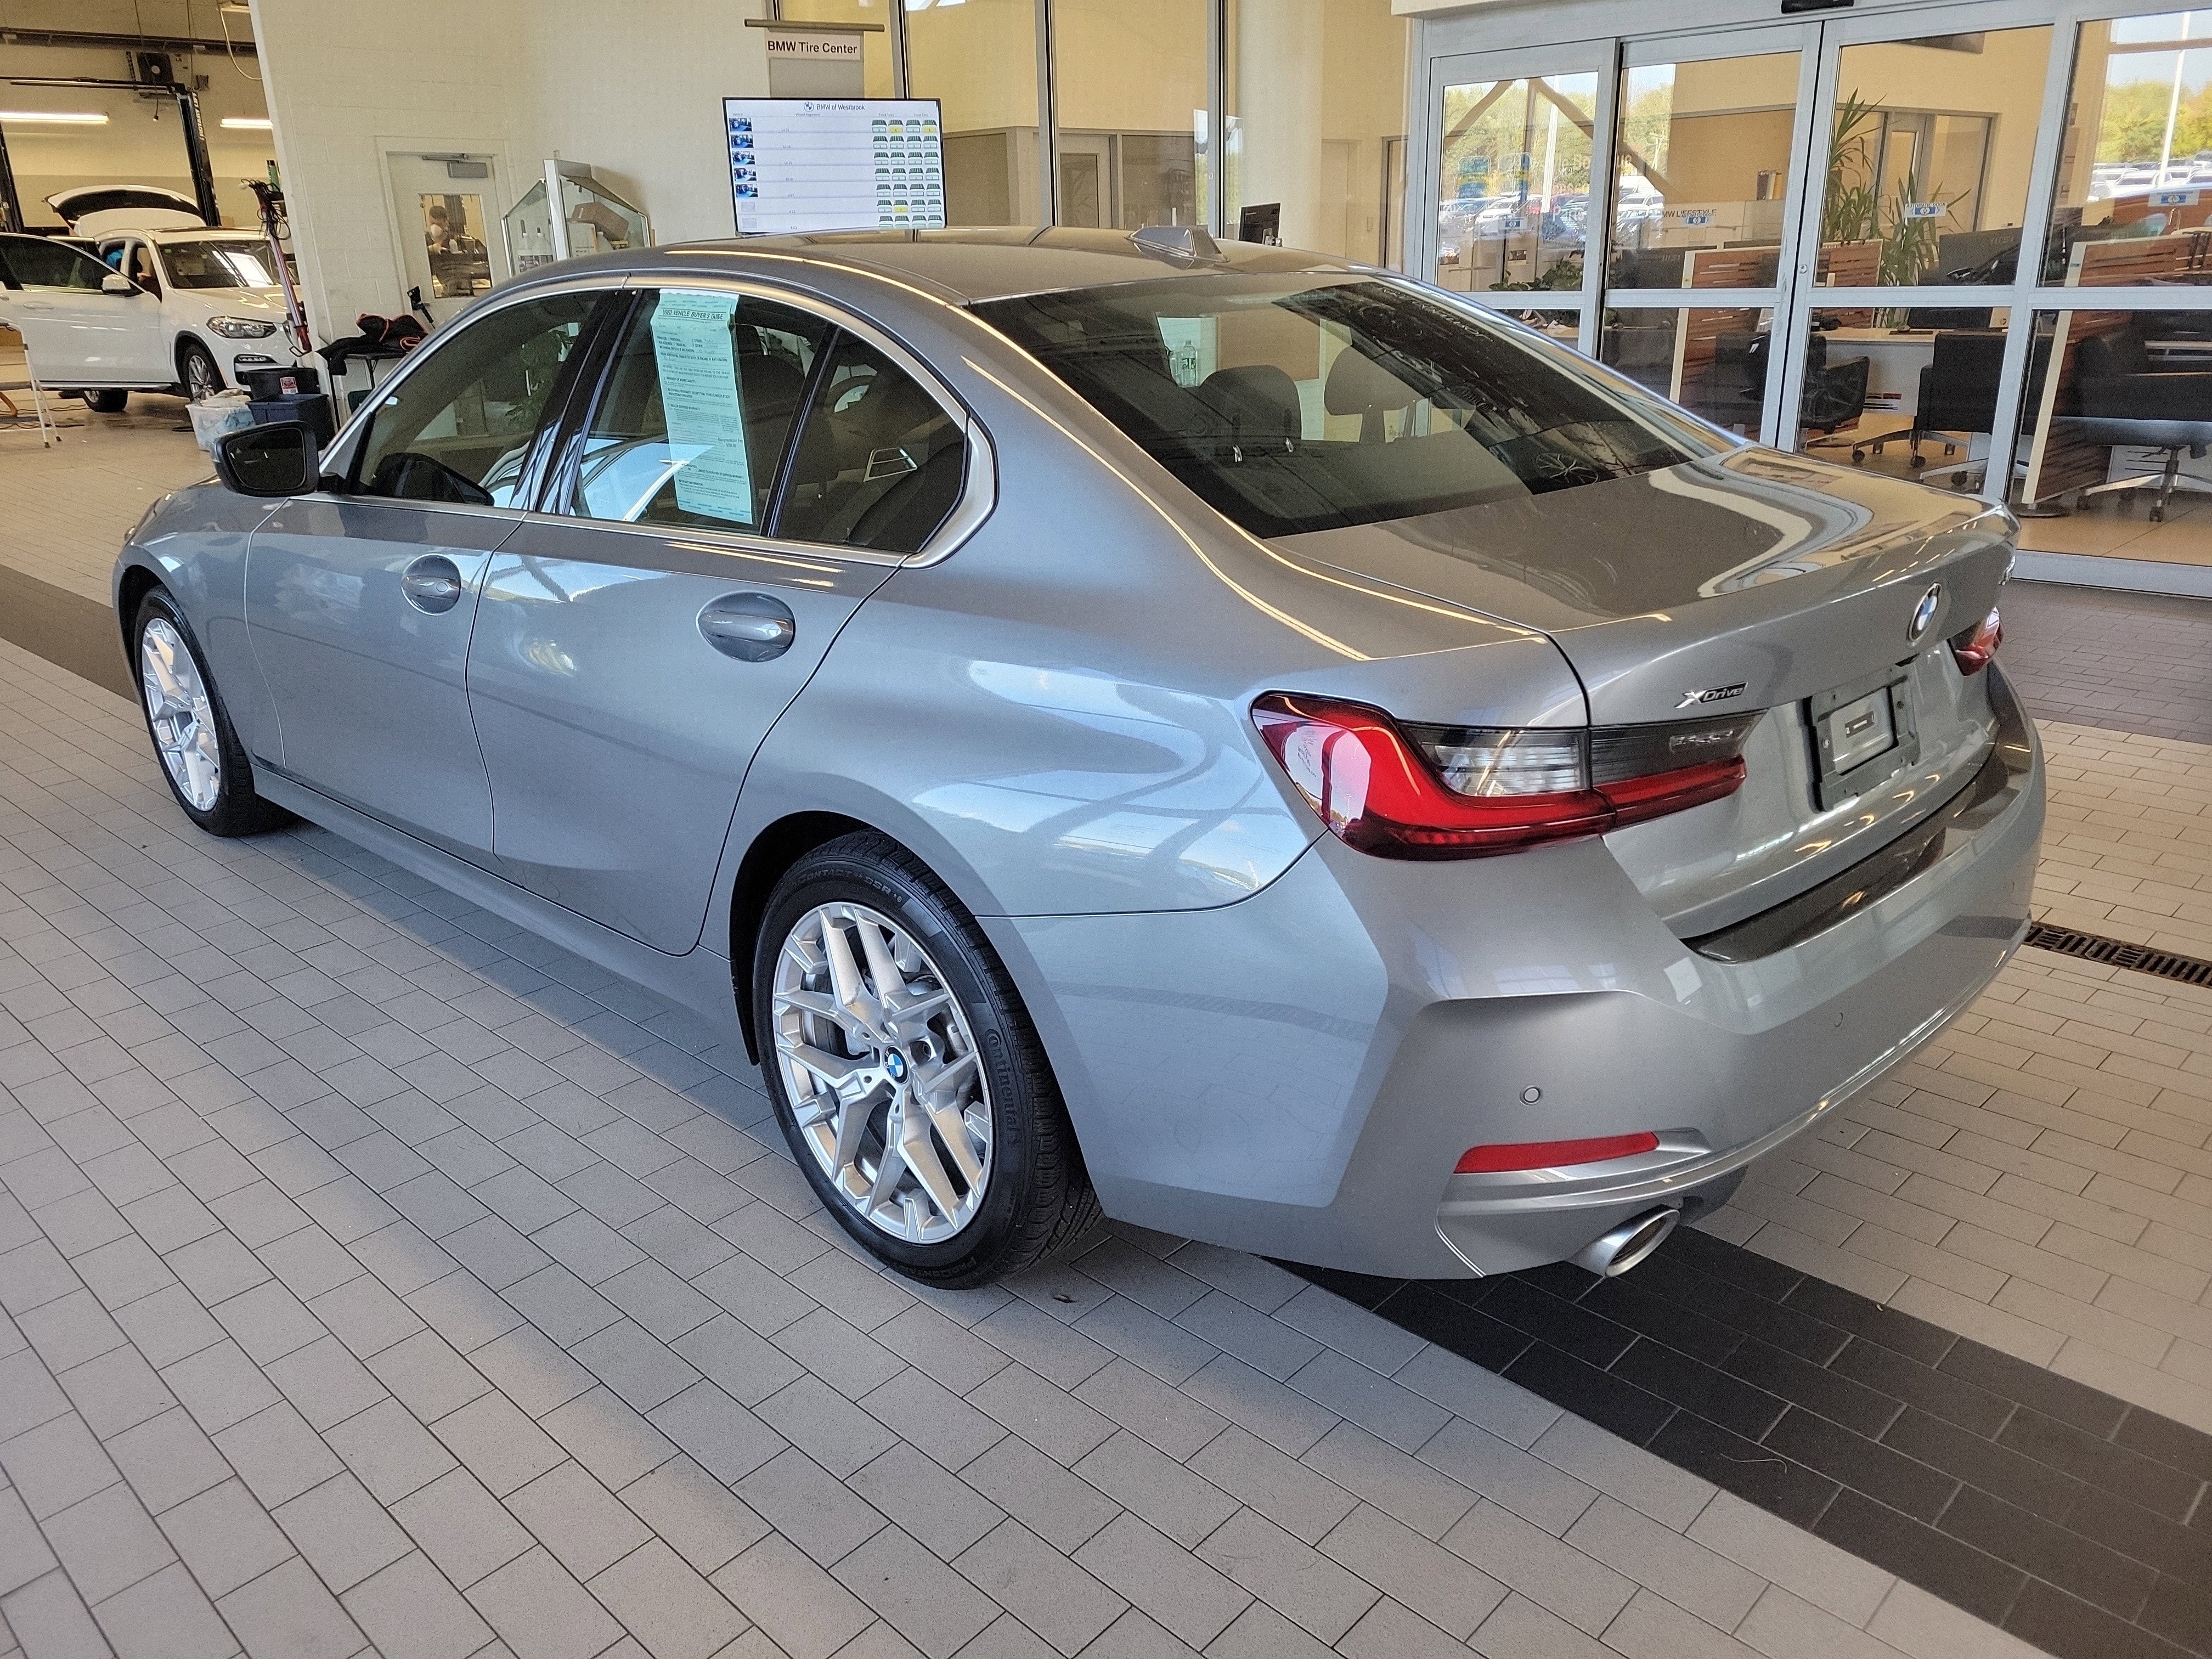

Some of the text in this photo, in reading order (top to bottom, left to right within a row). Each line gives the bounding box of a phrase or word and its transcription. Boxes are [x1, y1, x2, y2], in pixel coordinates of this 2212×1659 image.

[768, 41, 857, 54] BMW Tire Center
[864, 878, 892, 895] SSR
[984, 1029, 1019, 1131] Continental
